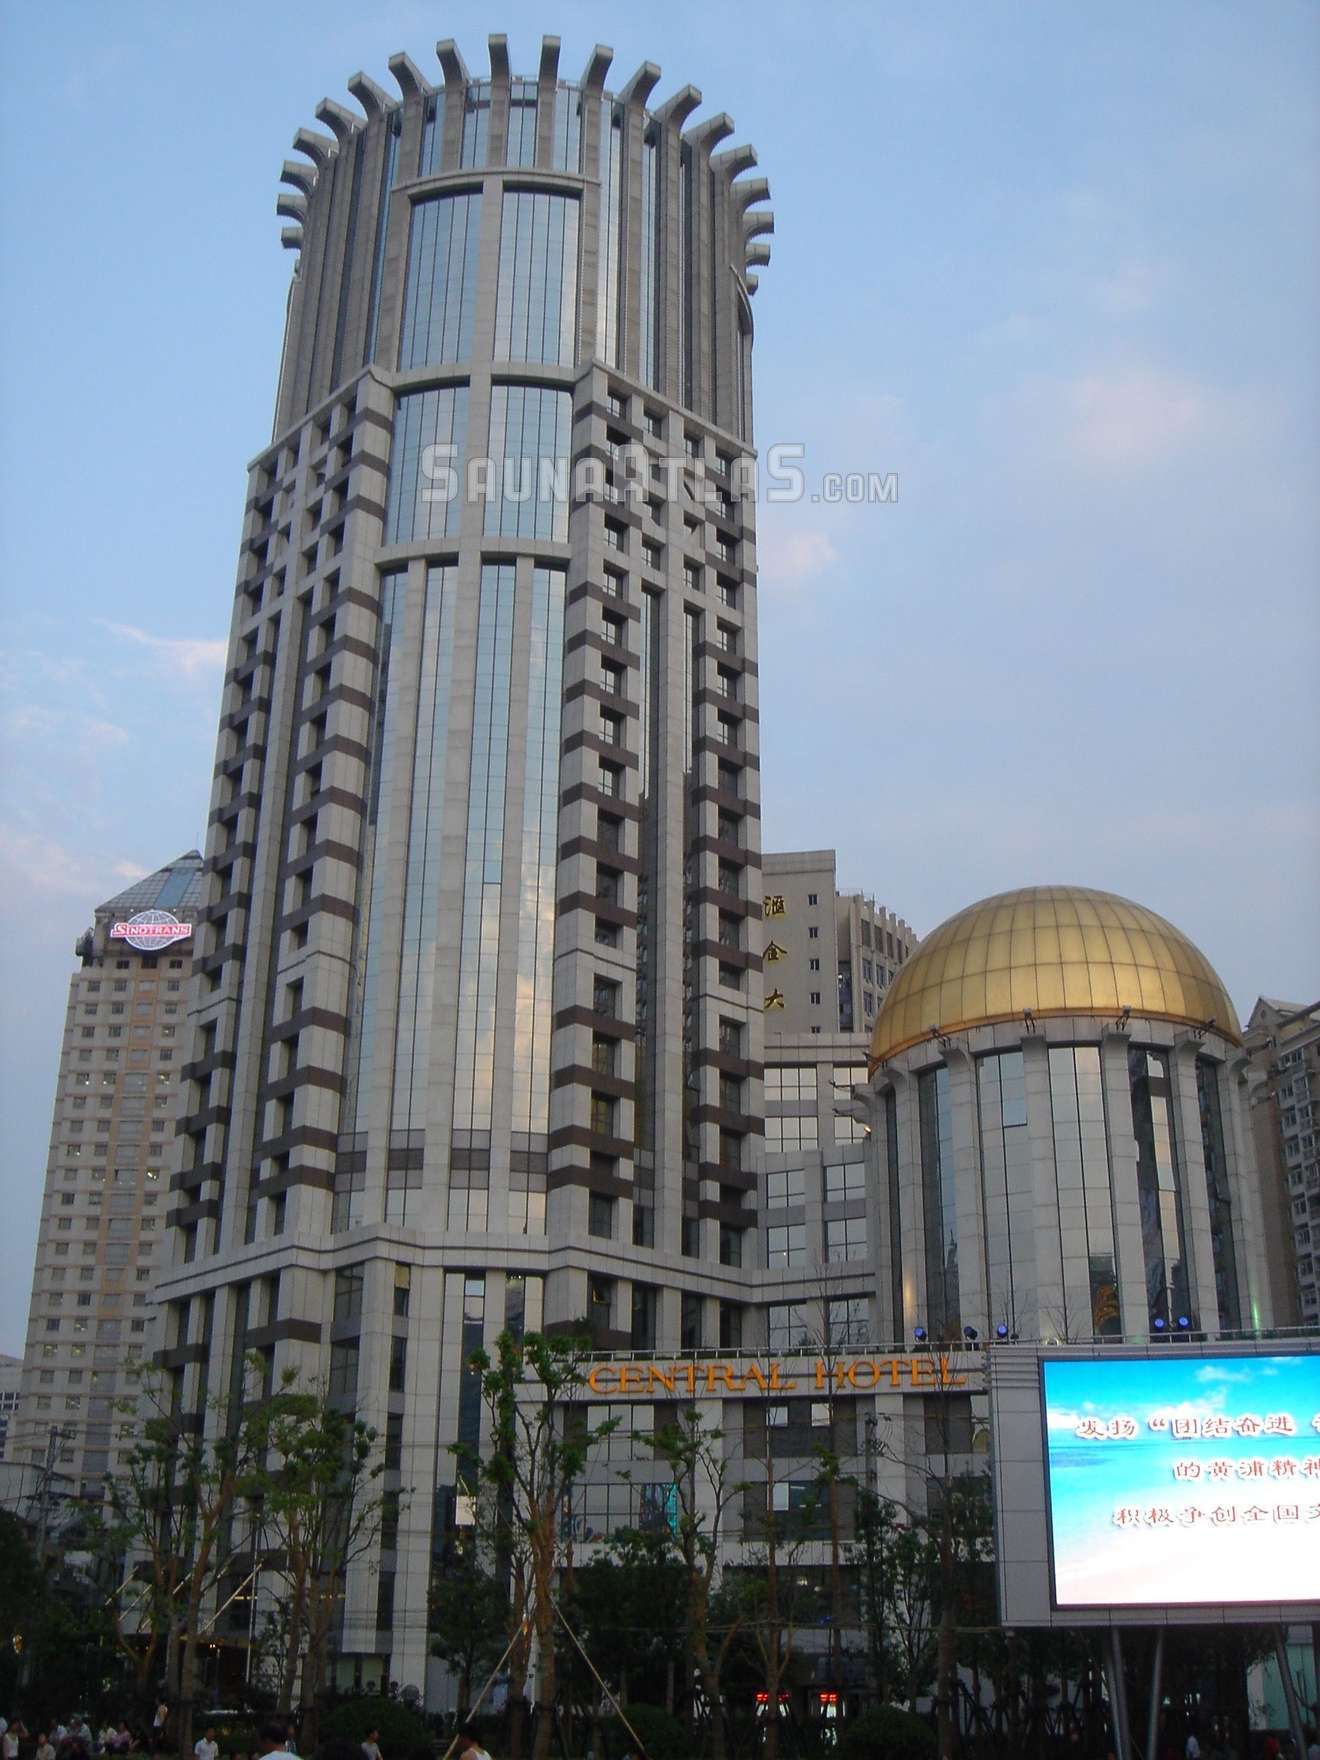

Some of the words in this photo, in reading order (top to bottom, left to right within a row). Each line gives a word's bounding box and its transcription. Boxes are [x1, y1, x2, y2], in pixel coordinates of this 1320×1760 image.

[112, 923, 190, 937] SINOTRANS
[588, 1361, 796, 1394] CENTRAL
[815, 1355, 967, 1390] HOTEL
